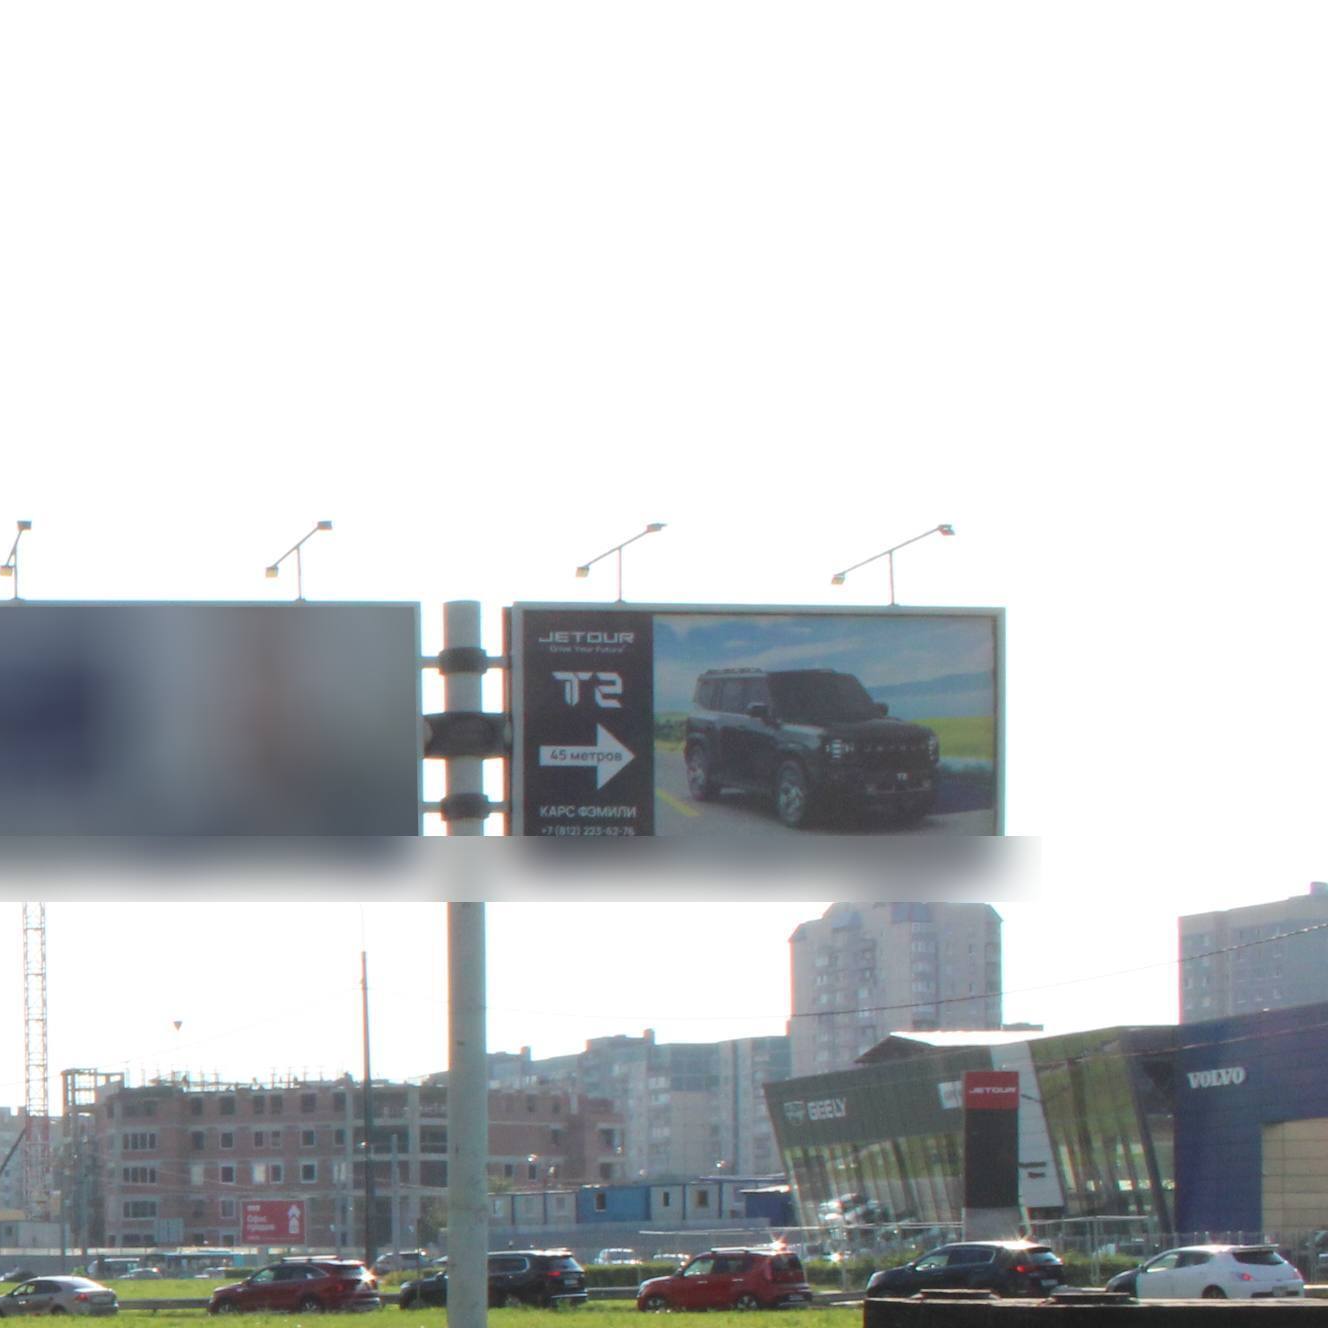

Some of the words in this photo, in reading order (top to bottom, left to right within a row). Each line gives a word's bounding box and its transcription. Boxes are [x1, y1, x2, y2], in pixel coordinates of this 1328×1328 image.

[538, 631, 635, 644] JETOUR
[552, 671, 624, 708] T2
[550, 750, 566, 760] 45
[571, 751, 623, 763] метров
[539, 806, 575, 818] КАРС
[578, 806, 637, 818] ФЭМИЛИ
[1186, 1066, 1246, 1089] VOLVO
[807, 1097, 847, 1121] GEELY
